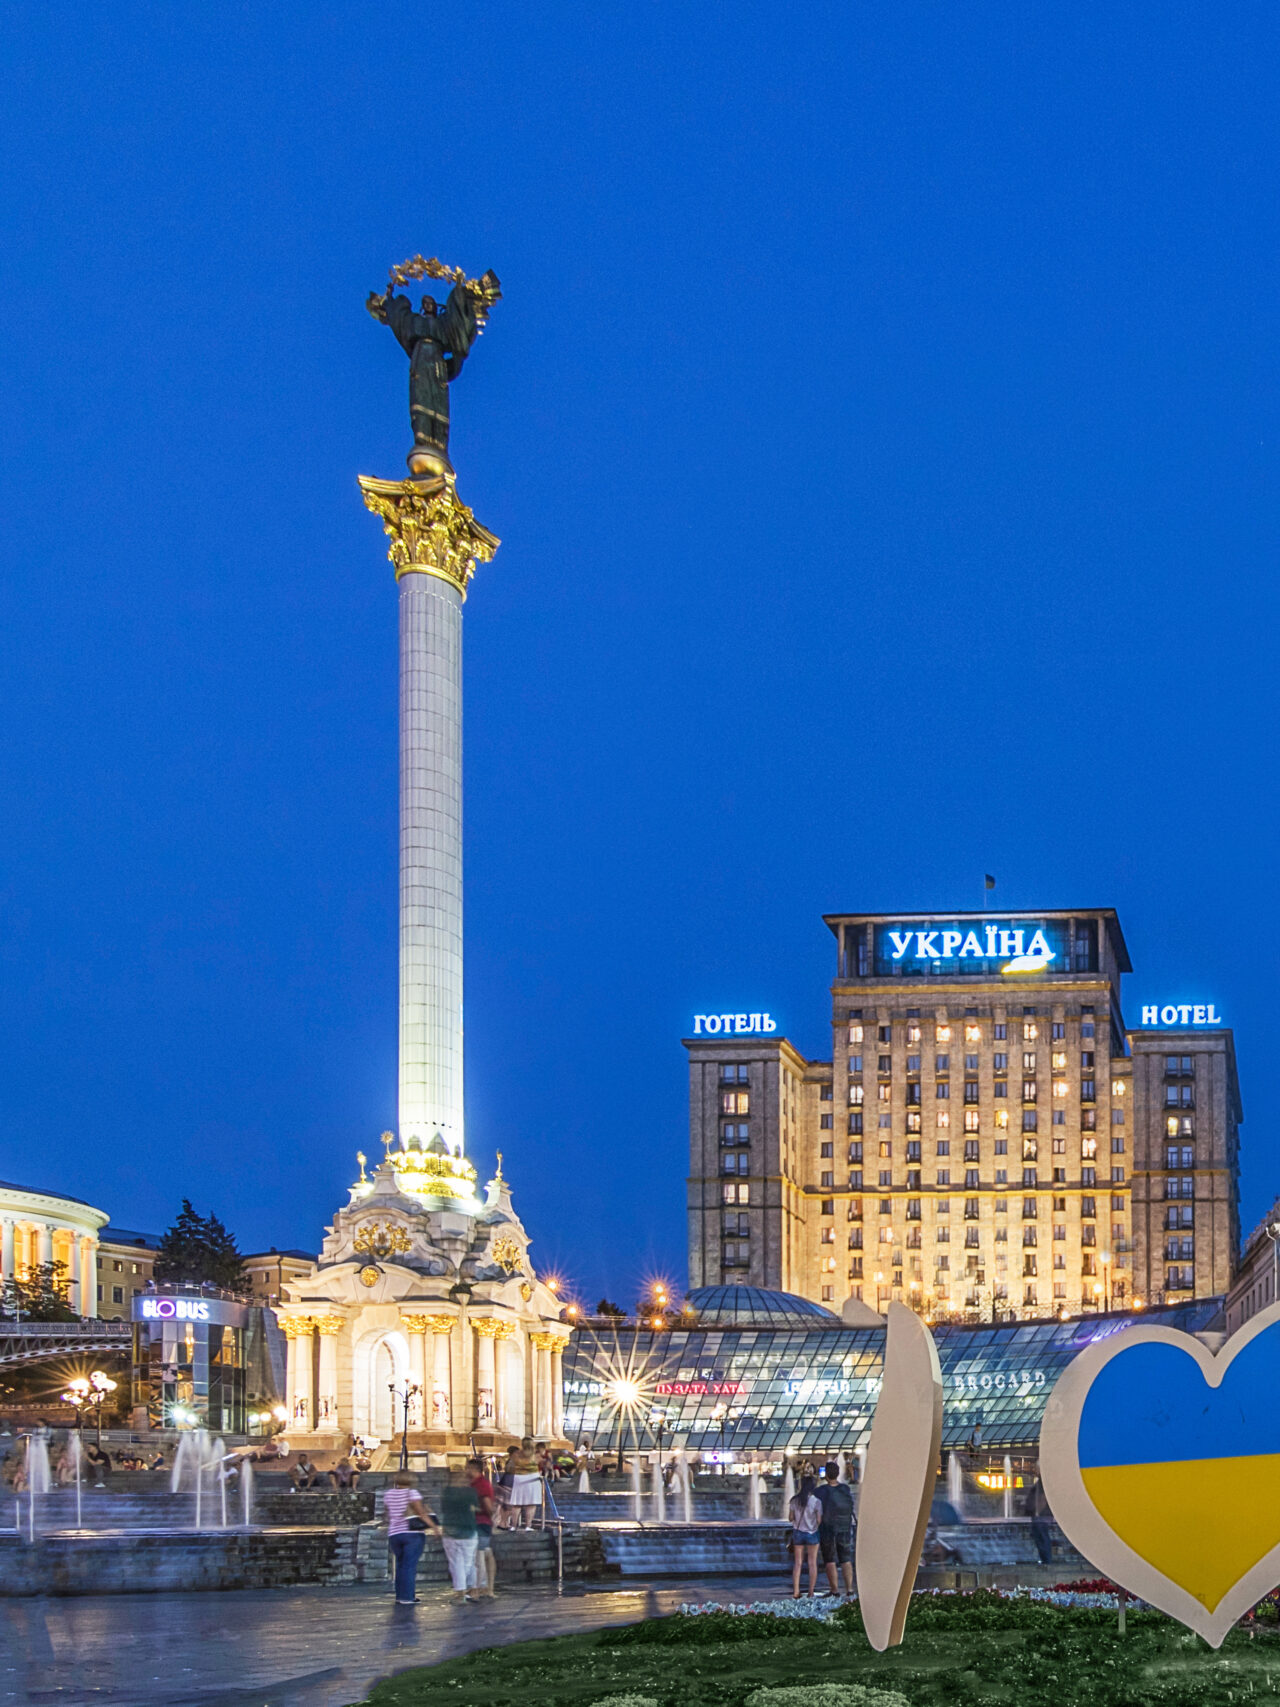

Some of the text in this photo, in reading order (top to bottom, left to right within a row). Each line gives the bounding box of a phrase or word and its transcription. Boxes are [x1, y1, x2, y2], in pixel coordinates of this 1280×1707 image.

[888, 924, 1052, 959] УКРАЇНА
[693, 1013, 777, 1034] ГОТЕЛЬ
[1141, 1004, 1222, 1025] HOTEL
[142, 1300, 209, 1320] GLOBUS
[655, 1383, 746, 1394] ПУЗАТА ХАТА
